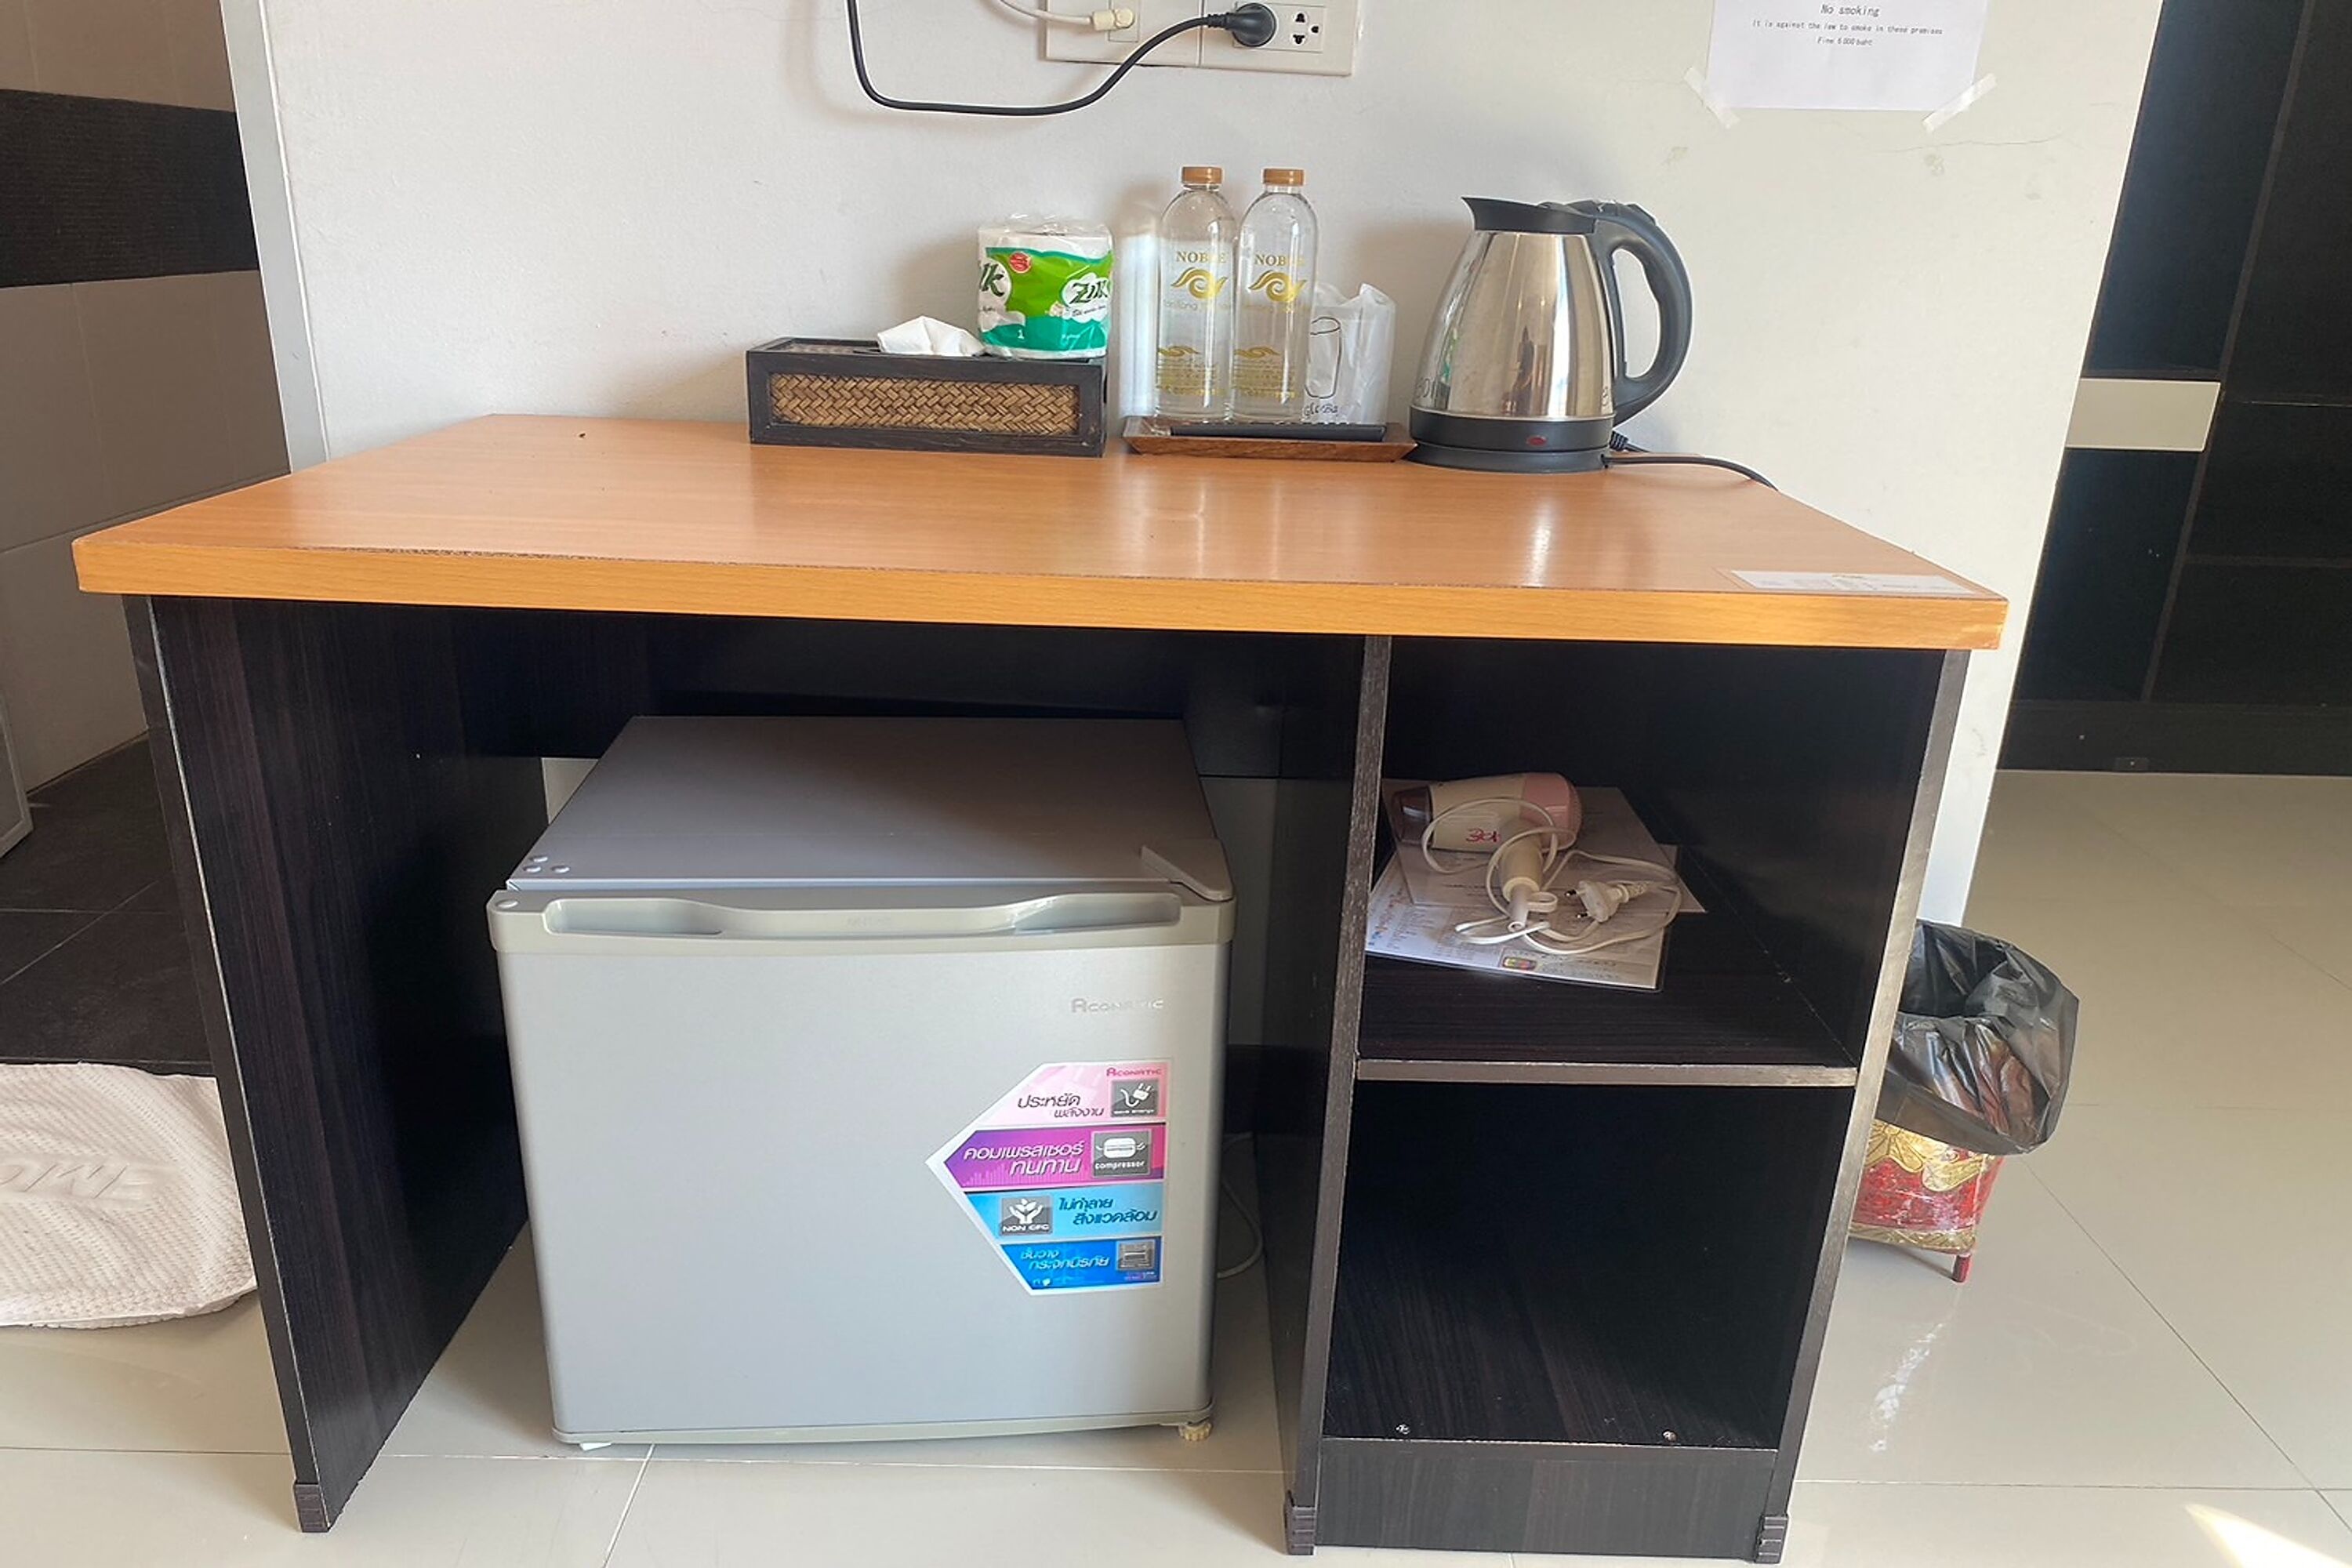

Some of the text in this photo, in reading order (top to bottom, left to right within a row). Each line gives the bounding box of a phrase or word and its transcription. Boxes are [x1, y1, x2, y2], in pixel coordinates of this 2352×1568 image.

[1820, 4, 1879, 17] No smoking
[1177, 251, 1229, 263] NOBE
[1018, 1093, 1080, 1108] ประหยัด
[1010, 1158, 1081, 1176] ทนทาน
[1095, 1160, 1145, 1171] compressor
